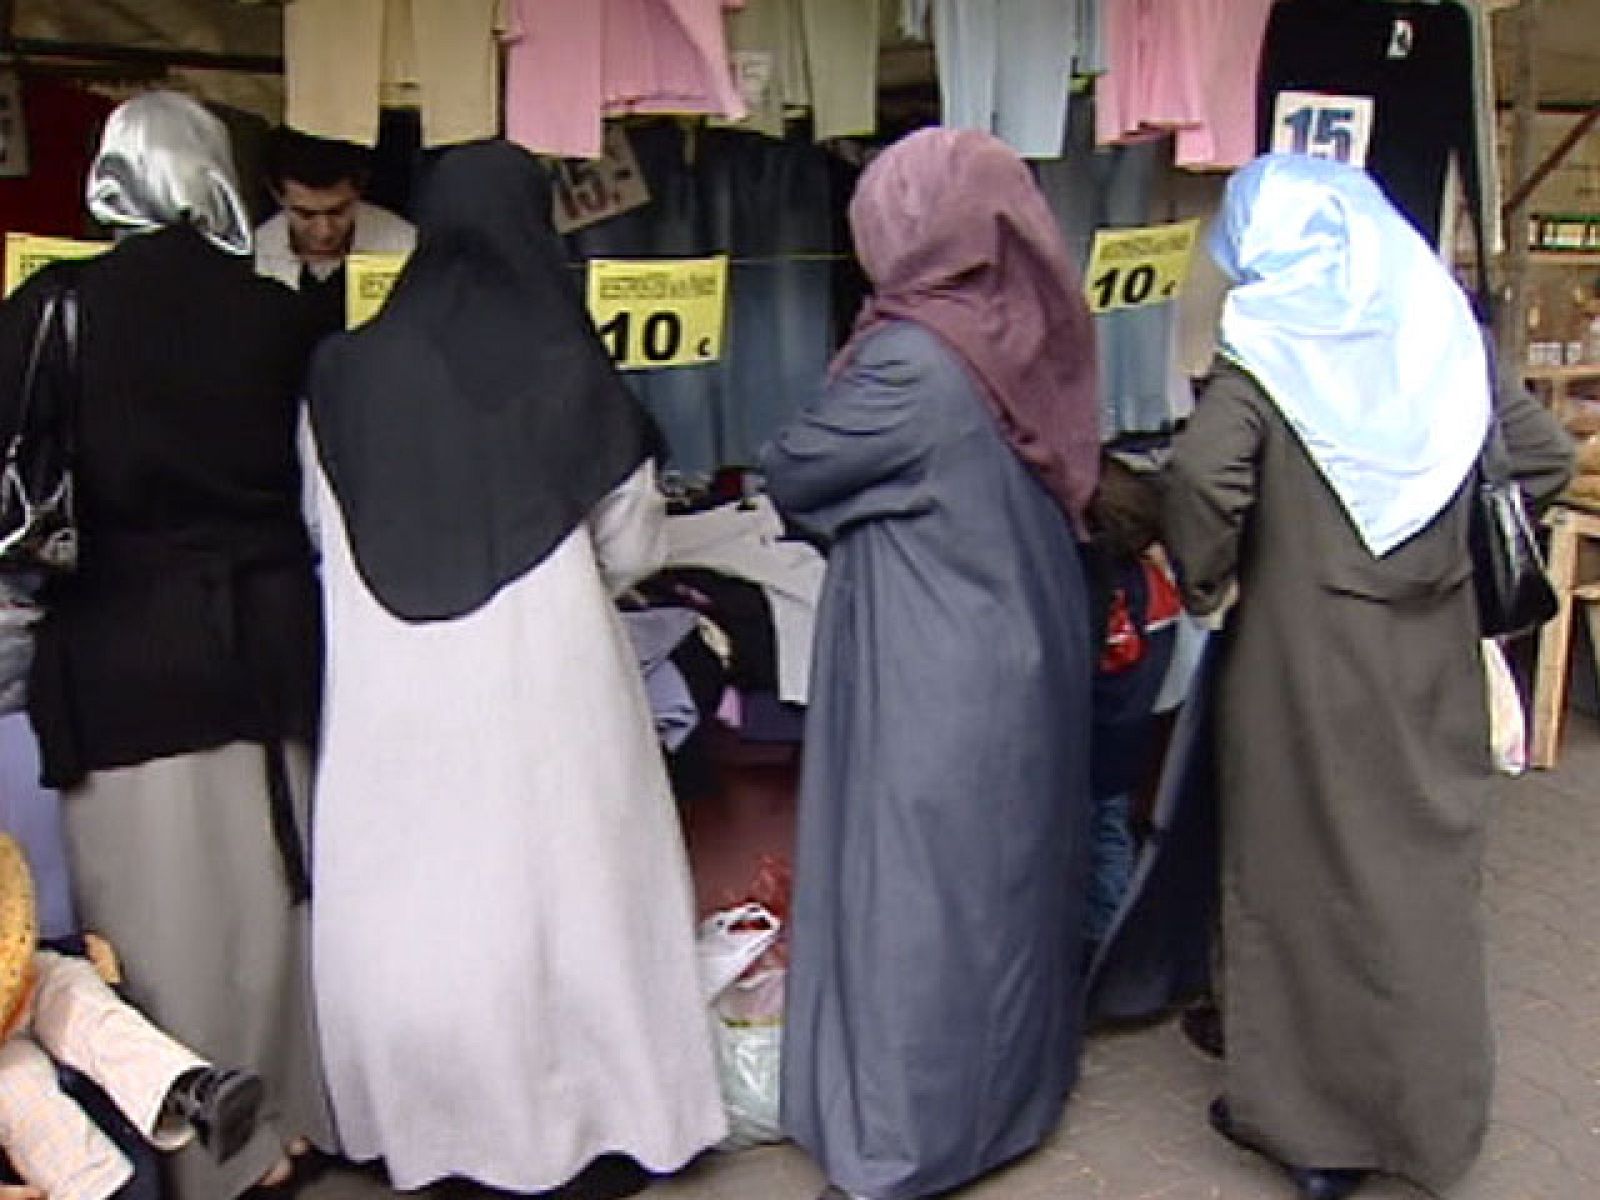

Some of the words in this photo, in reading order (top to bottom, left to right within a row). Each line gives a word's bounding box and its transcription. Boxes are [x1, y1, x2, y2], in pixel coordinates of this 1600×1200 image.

[1283, 106, 1353, 162] 15
[1093, 264, 1155, 308] 10
[599, 309, 681, 361] 10
